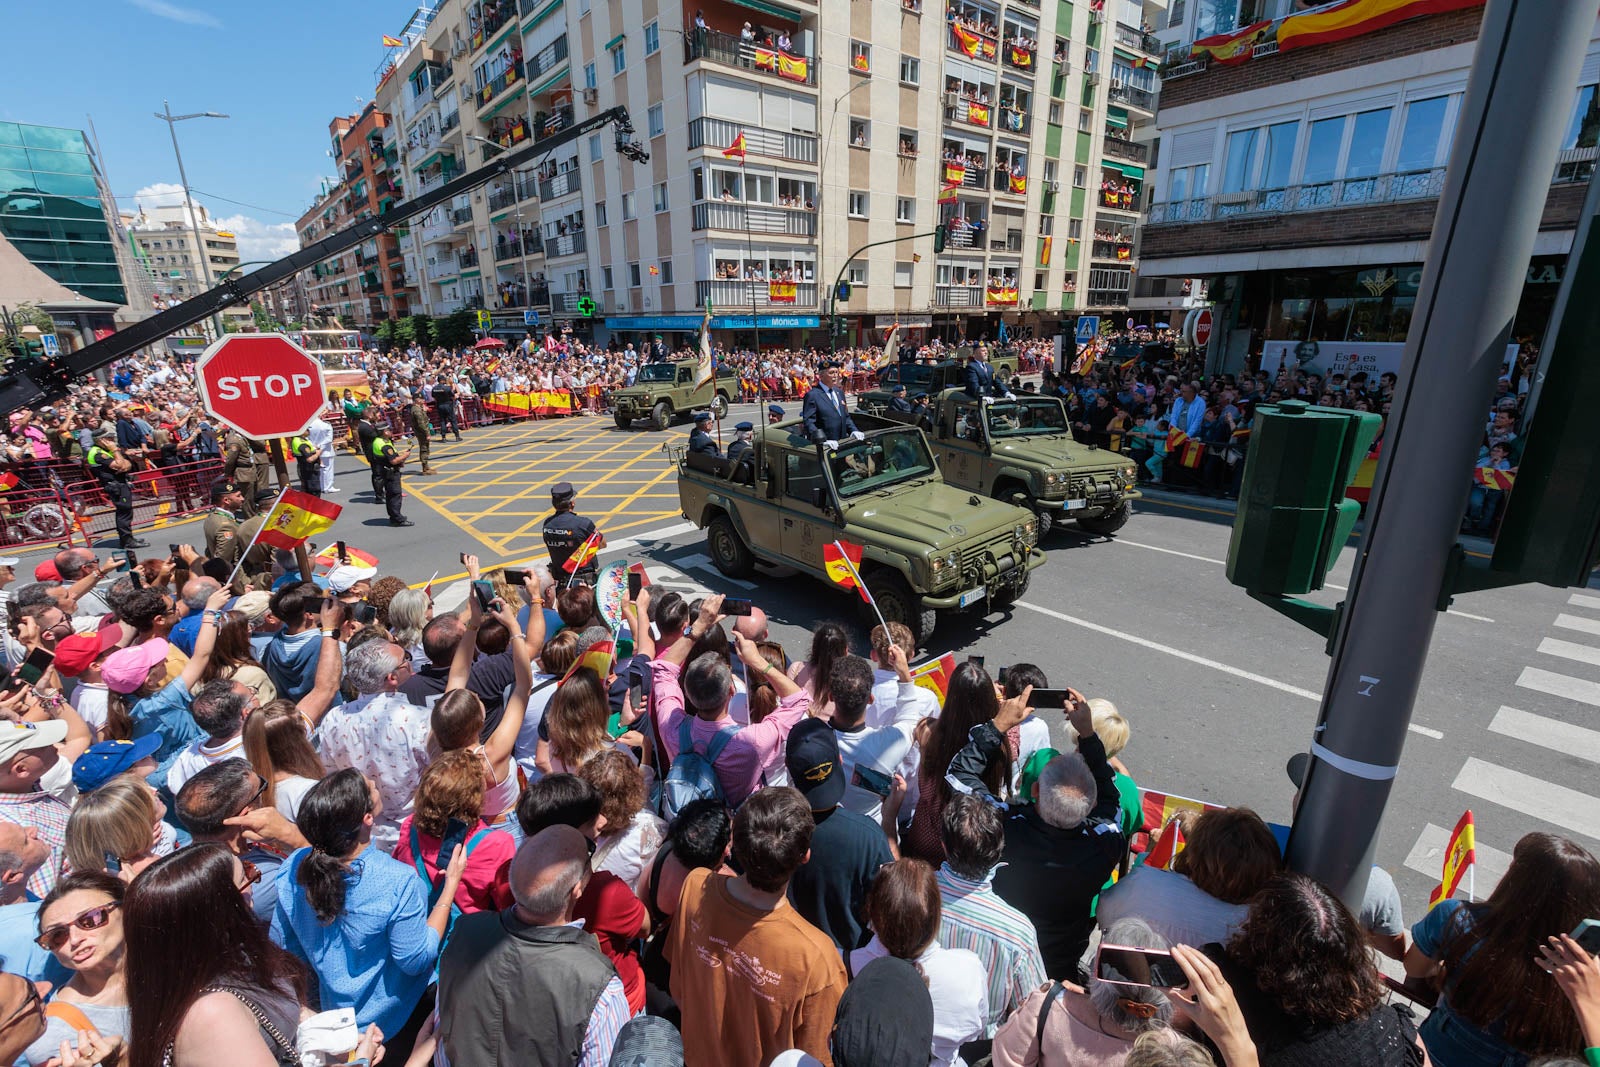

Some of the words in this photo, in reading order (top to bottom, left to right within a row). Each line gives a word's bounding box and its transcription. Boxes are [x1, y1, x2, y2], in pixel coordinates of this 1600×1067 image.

[1197, 323, 1211, 333] STOP
[1363, 354, 1376, 362] es
[1333, 362, 1345, 371] tu
[217, 373, 312, 400] STOP
[765, 969, 782, 979] FROM
